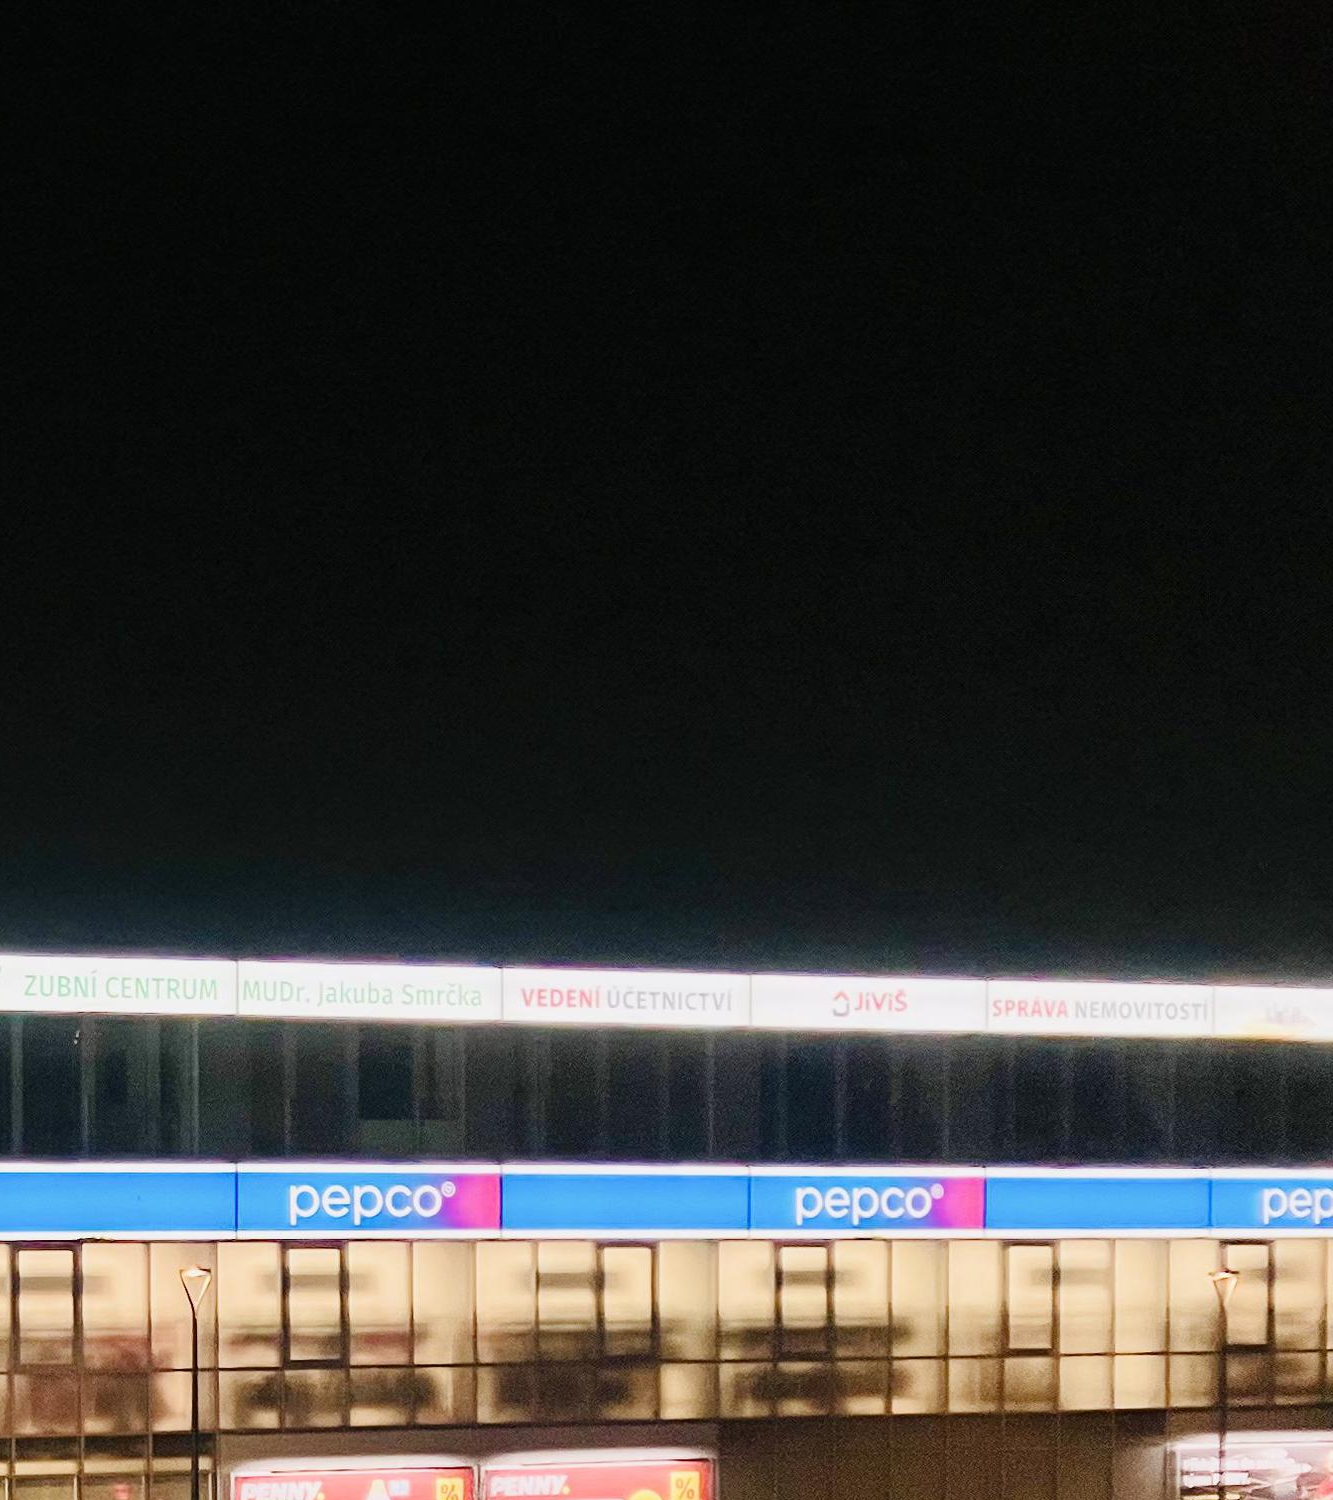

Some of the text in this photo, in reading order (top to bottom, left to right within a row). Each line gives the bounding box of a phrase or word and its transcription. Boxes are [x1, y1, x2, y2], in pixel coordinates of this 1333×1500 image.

[23, 968, 483, 1008] ZUBNÍ CENTRUM MUDr. Jakuba Smrčka
[521, 984, 734, 1012] VEDENÍ ÚČETNICTVÍ
[991, 996, 1210, 1022] SPRÁVA NEMOVITOSTÍ
[288, 1180, 443, 1227] pepco
[794, 1182, 934, 1226] pepco
